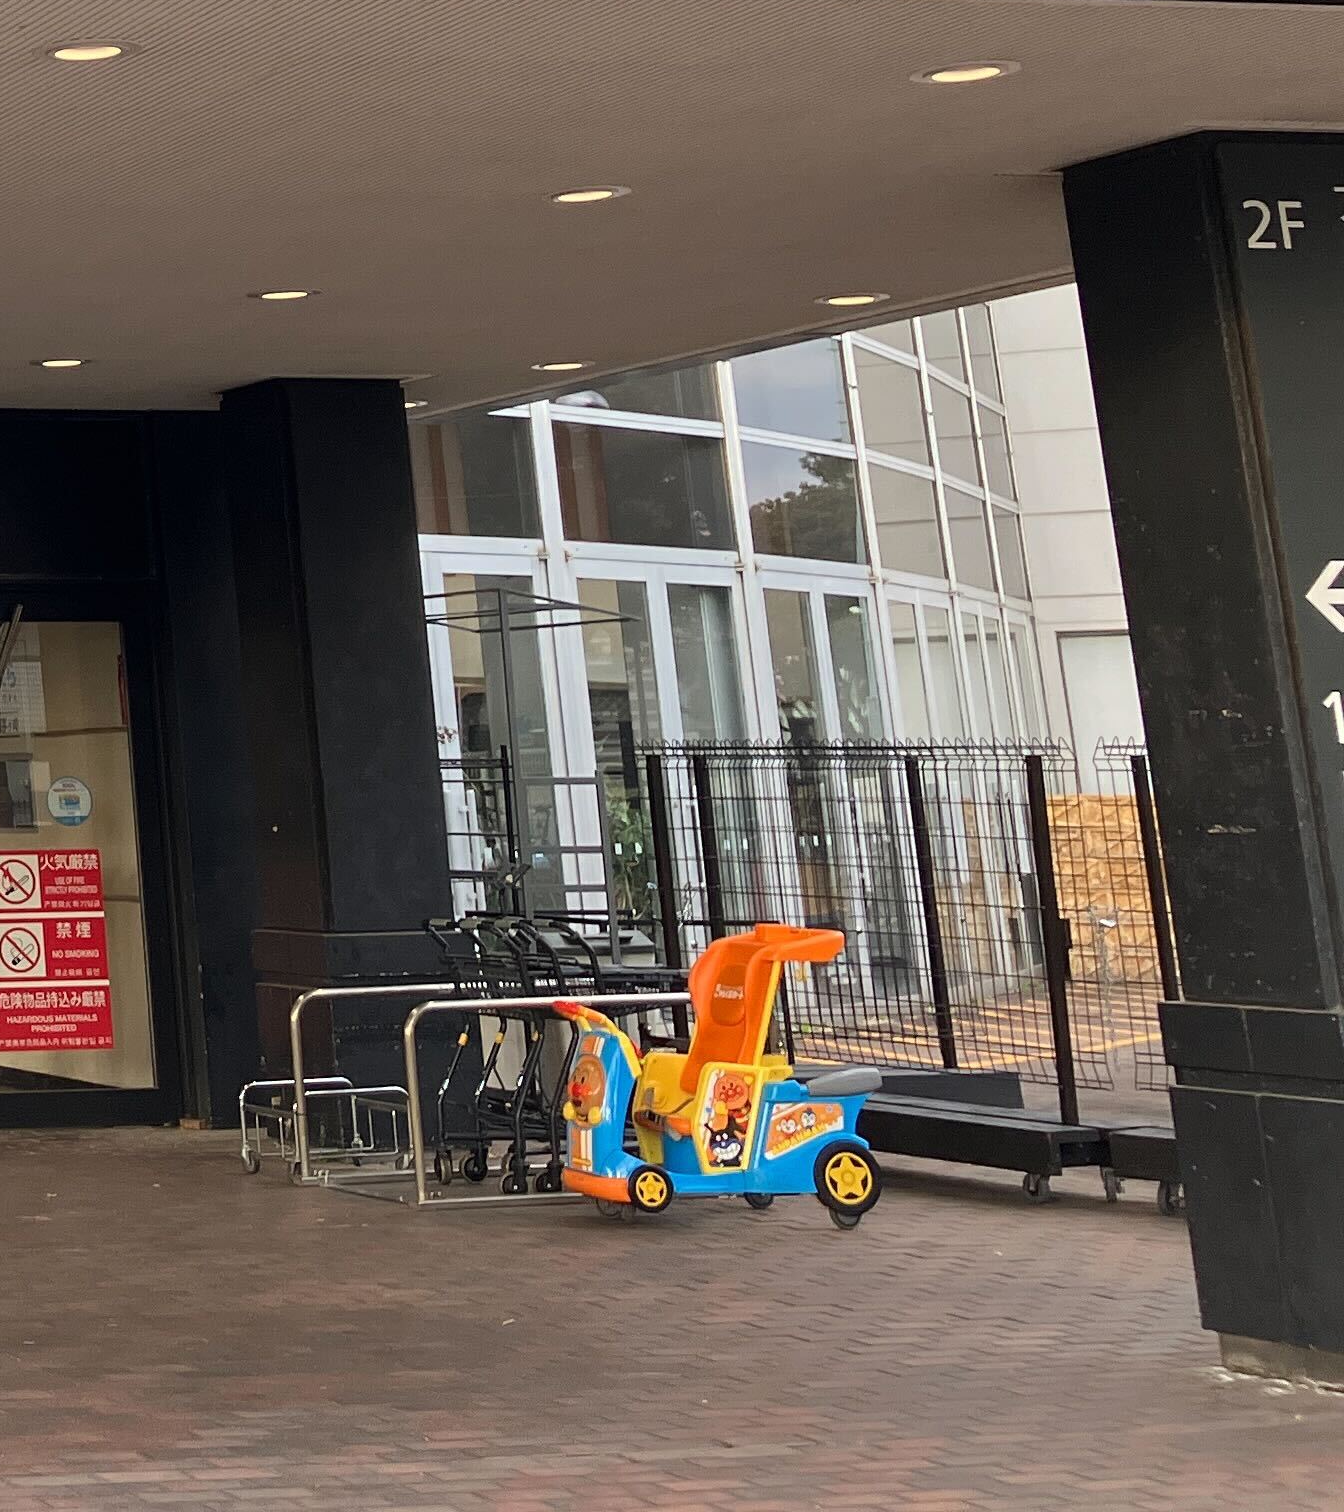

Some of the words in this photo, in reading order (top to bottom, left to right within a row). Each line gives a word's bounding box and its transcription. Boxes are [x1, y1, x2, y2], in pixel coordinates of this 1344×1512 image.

[1242, 199, 1305, 250] 2F
[39, 854, 99, 870] 火気厳禁
[56, 921, 92, 939] 禁煙
[52, 950, 64, 959] NO
[64, 949, 100, 959] SMOKING
[6, 1014, 54, 1024] HAZARDOUS
[54, 1013, 98, 1023] MATERIALS
[31, 1024, 78, 1033] PROHIBITED
